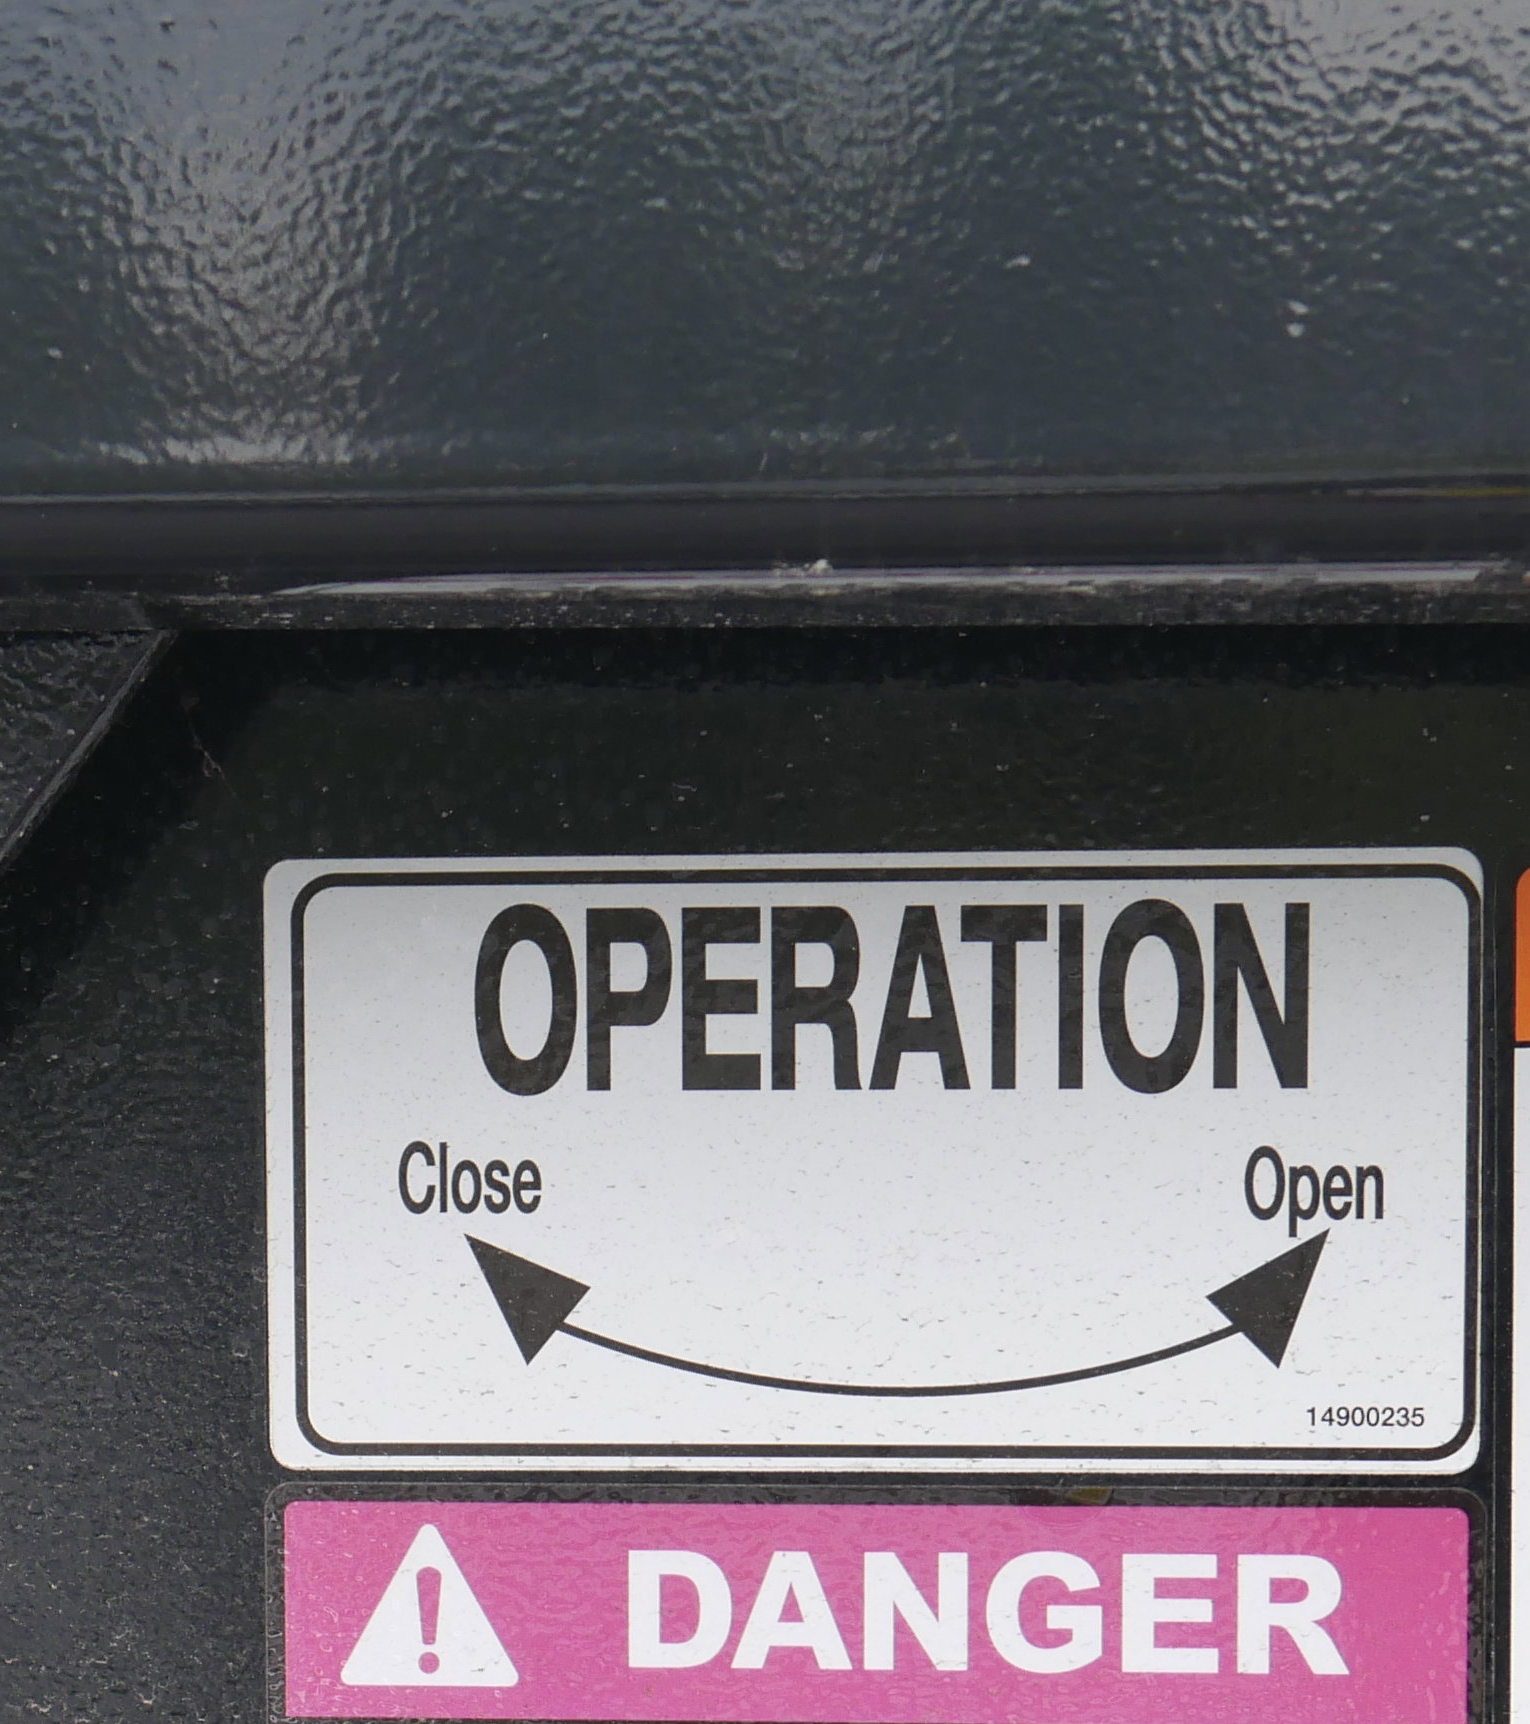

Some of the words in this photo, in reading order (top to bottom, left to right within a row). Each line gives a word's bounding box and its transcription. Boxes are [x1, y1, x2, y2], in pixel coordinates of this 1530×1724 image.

[475, 899, 1310, 1096] OPERATION
[399, 1141, 541, 1214] Close
[1245, 1146, 1383, 1237] Open
[1307, 1407, 1424, 1427] 14900235
[628, 1550, 1349, 1675] DANGER
